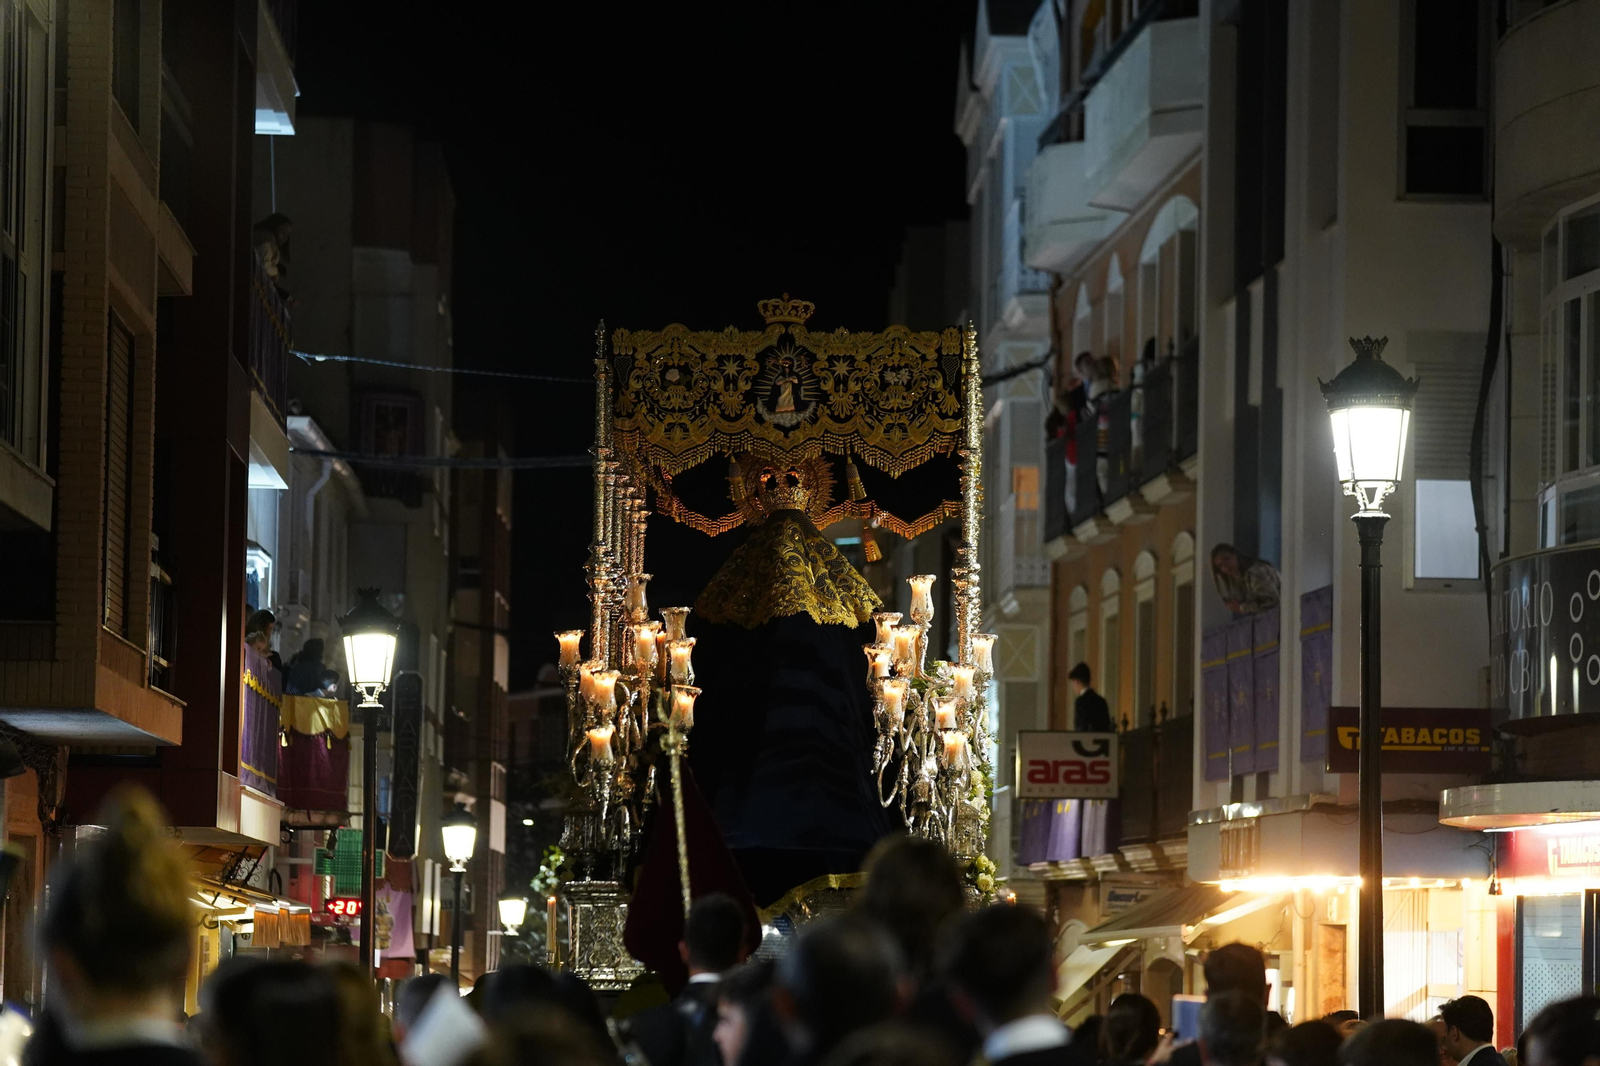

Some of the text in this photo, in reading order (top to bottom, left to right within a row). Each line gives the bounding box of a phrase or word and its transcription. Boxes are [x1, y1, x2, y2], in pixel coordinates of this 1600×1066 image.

[1381, 727, 1481, 745] ABACOS
[394, 697, 417, 850] FARMACIA
[1027, 760, 1110, 784] aras
